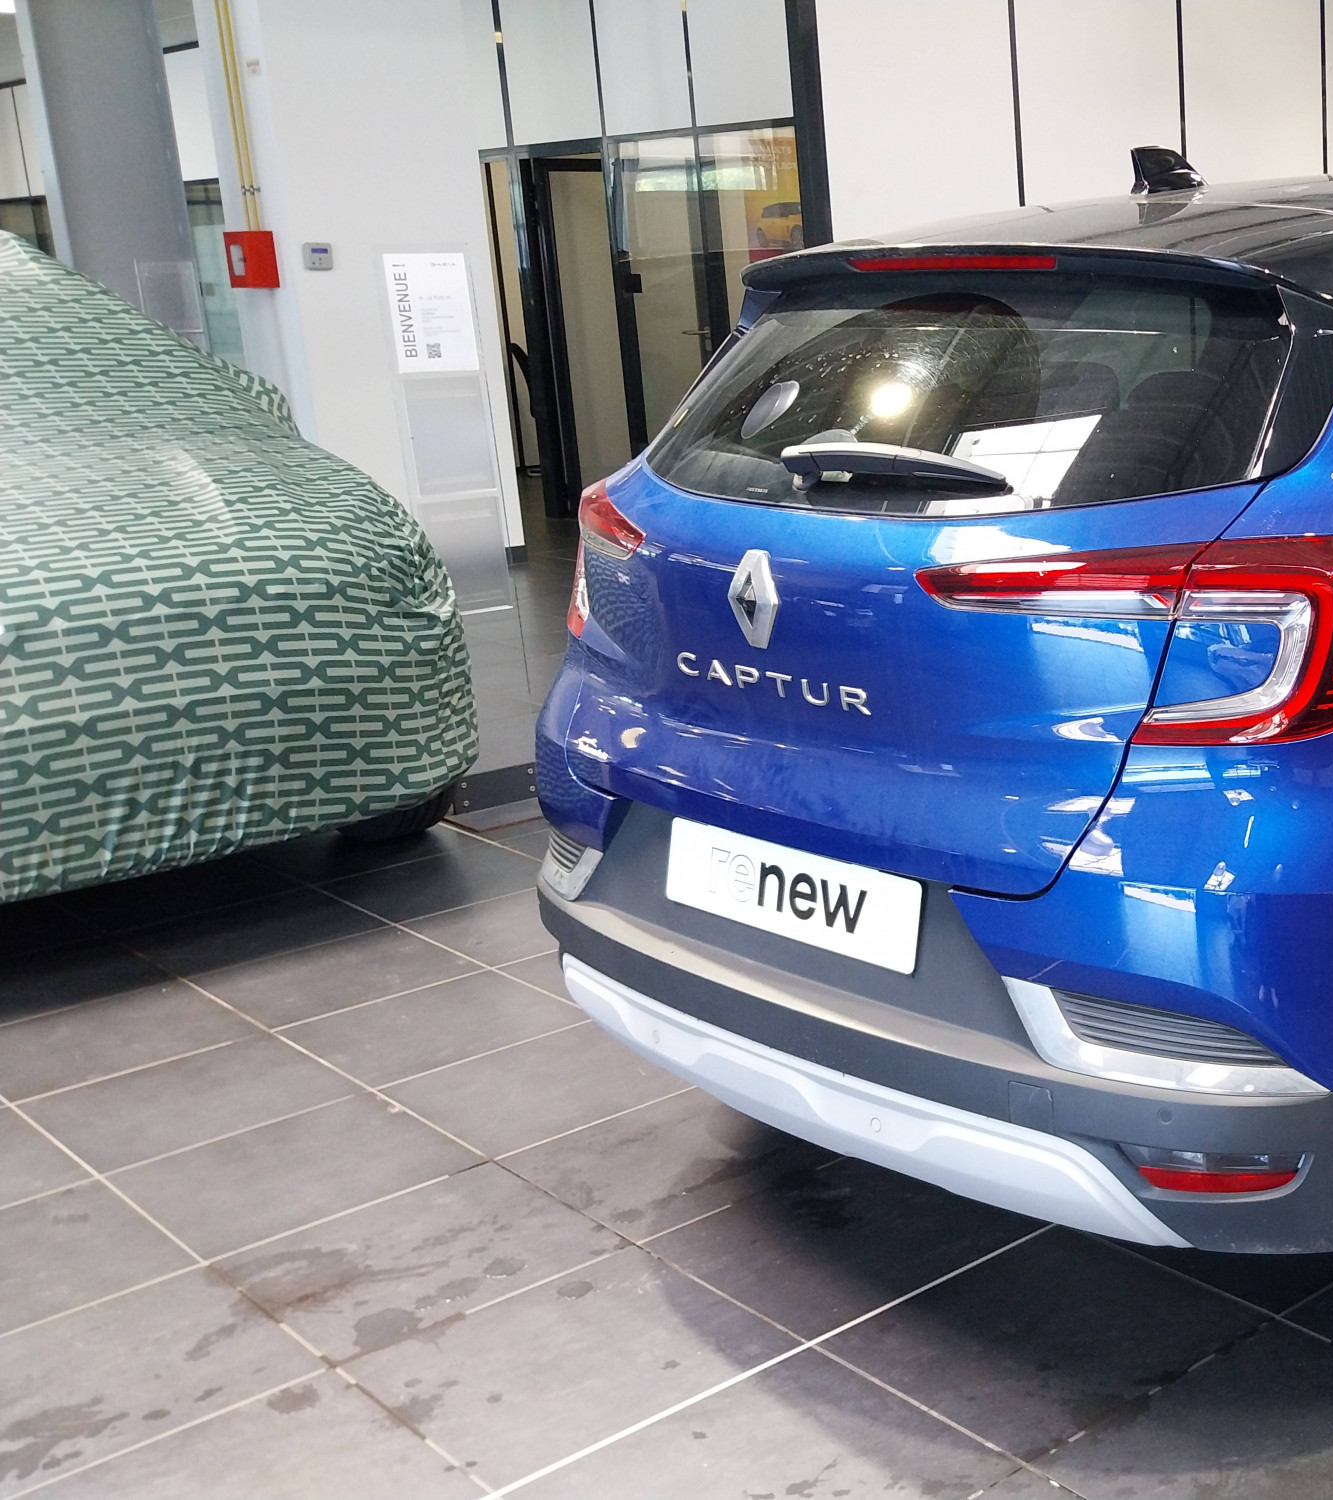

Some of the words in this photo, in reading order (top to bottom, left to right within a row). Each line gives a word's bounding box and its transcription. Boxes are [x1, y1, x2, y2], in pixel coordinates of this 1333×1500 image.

[393, 272, 418, 358] BIENVENUE
[676, 651, 872, 716] CAPTUR
[708, 846, 868, 934] renew
